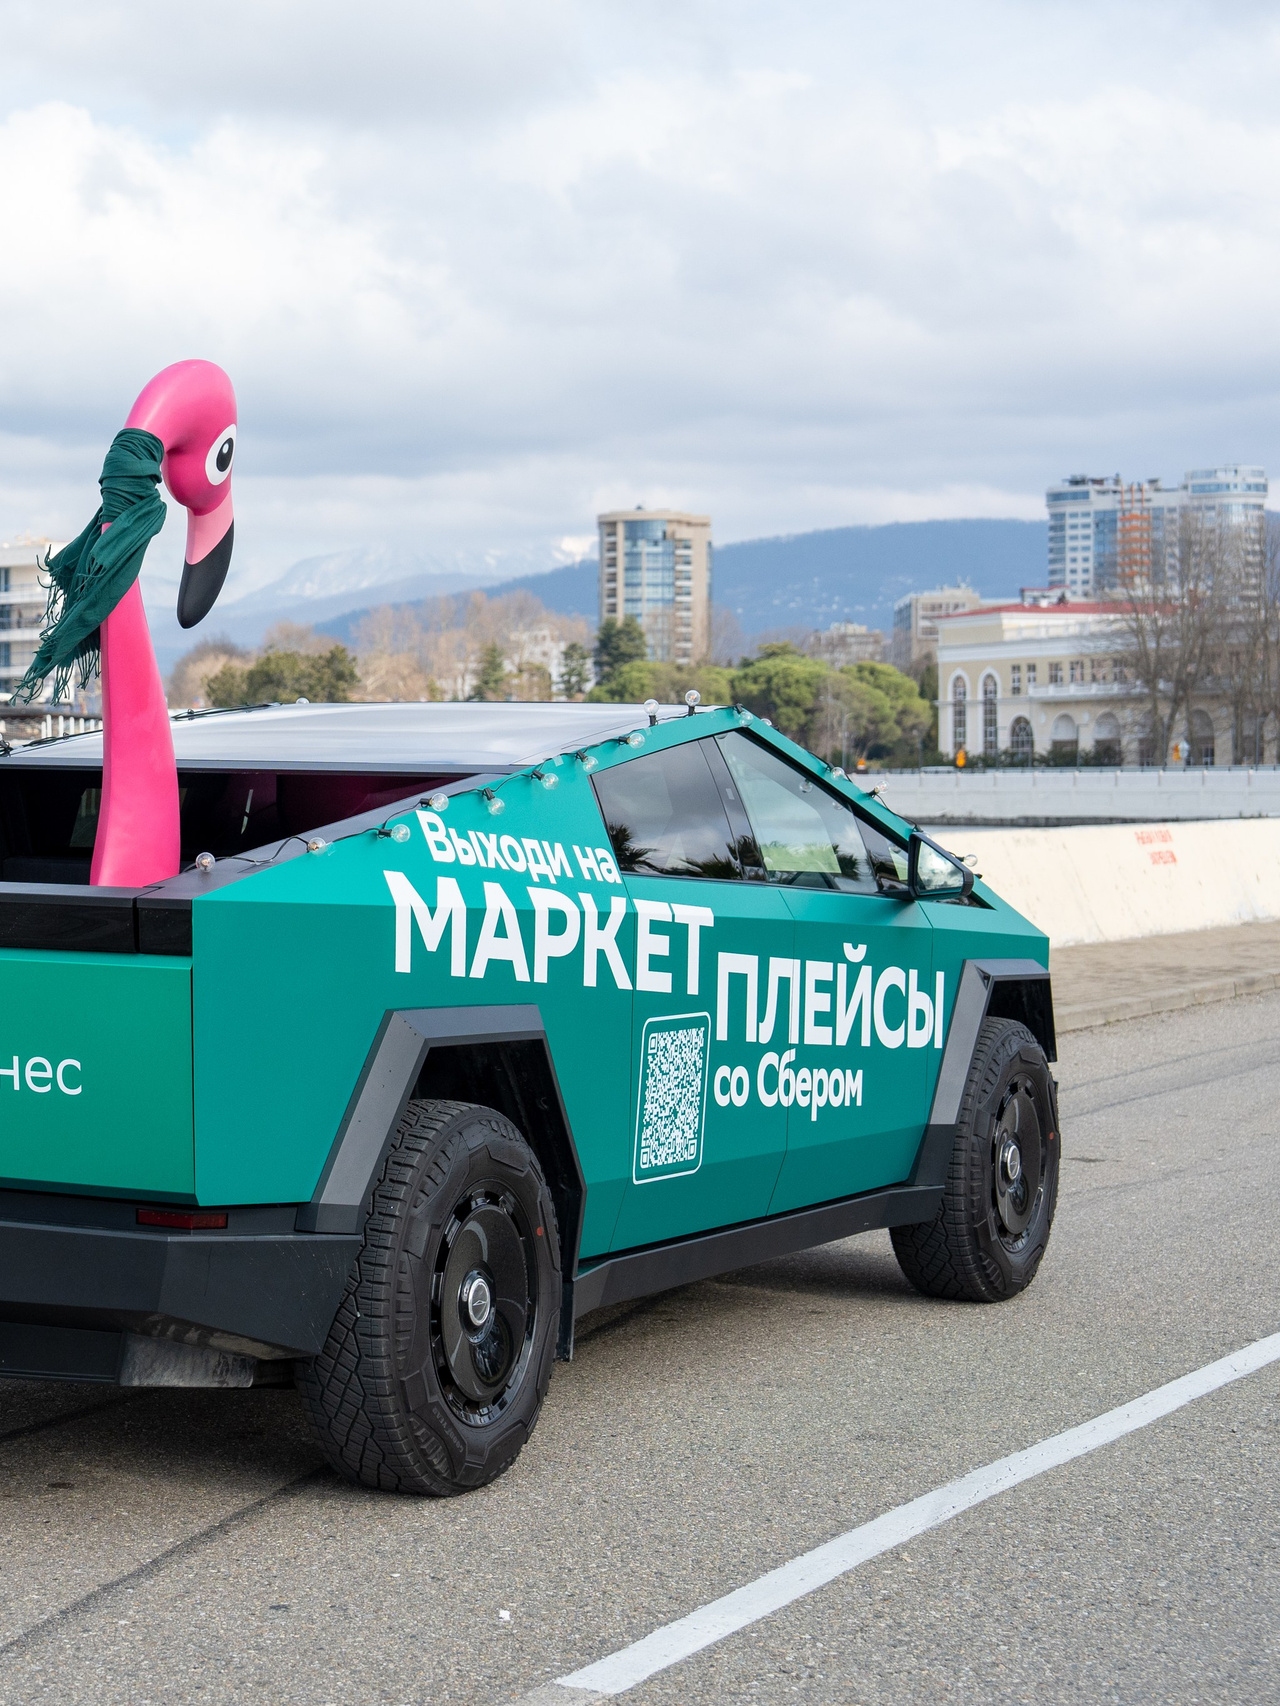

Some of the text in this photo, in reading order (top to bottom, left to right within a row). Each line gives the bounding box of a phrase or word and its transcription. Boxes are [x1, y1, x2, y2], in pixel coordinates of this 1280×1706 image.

[415, 809, 622, 885] Выходи на
[382, 869, 715, 996] МАРКЕТ
[716, 942, 945, 1050] ПЛЕЙСЫ
[713, 1050, 864, 1123] со Сбером
